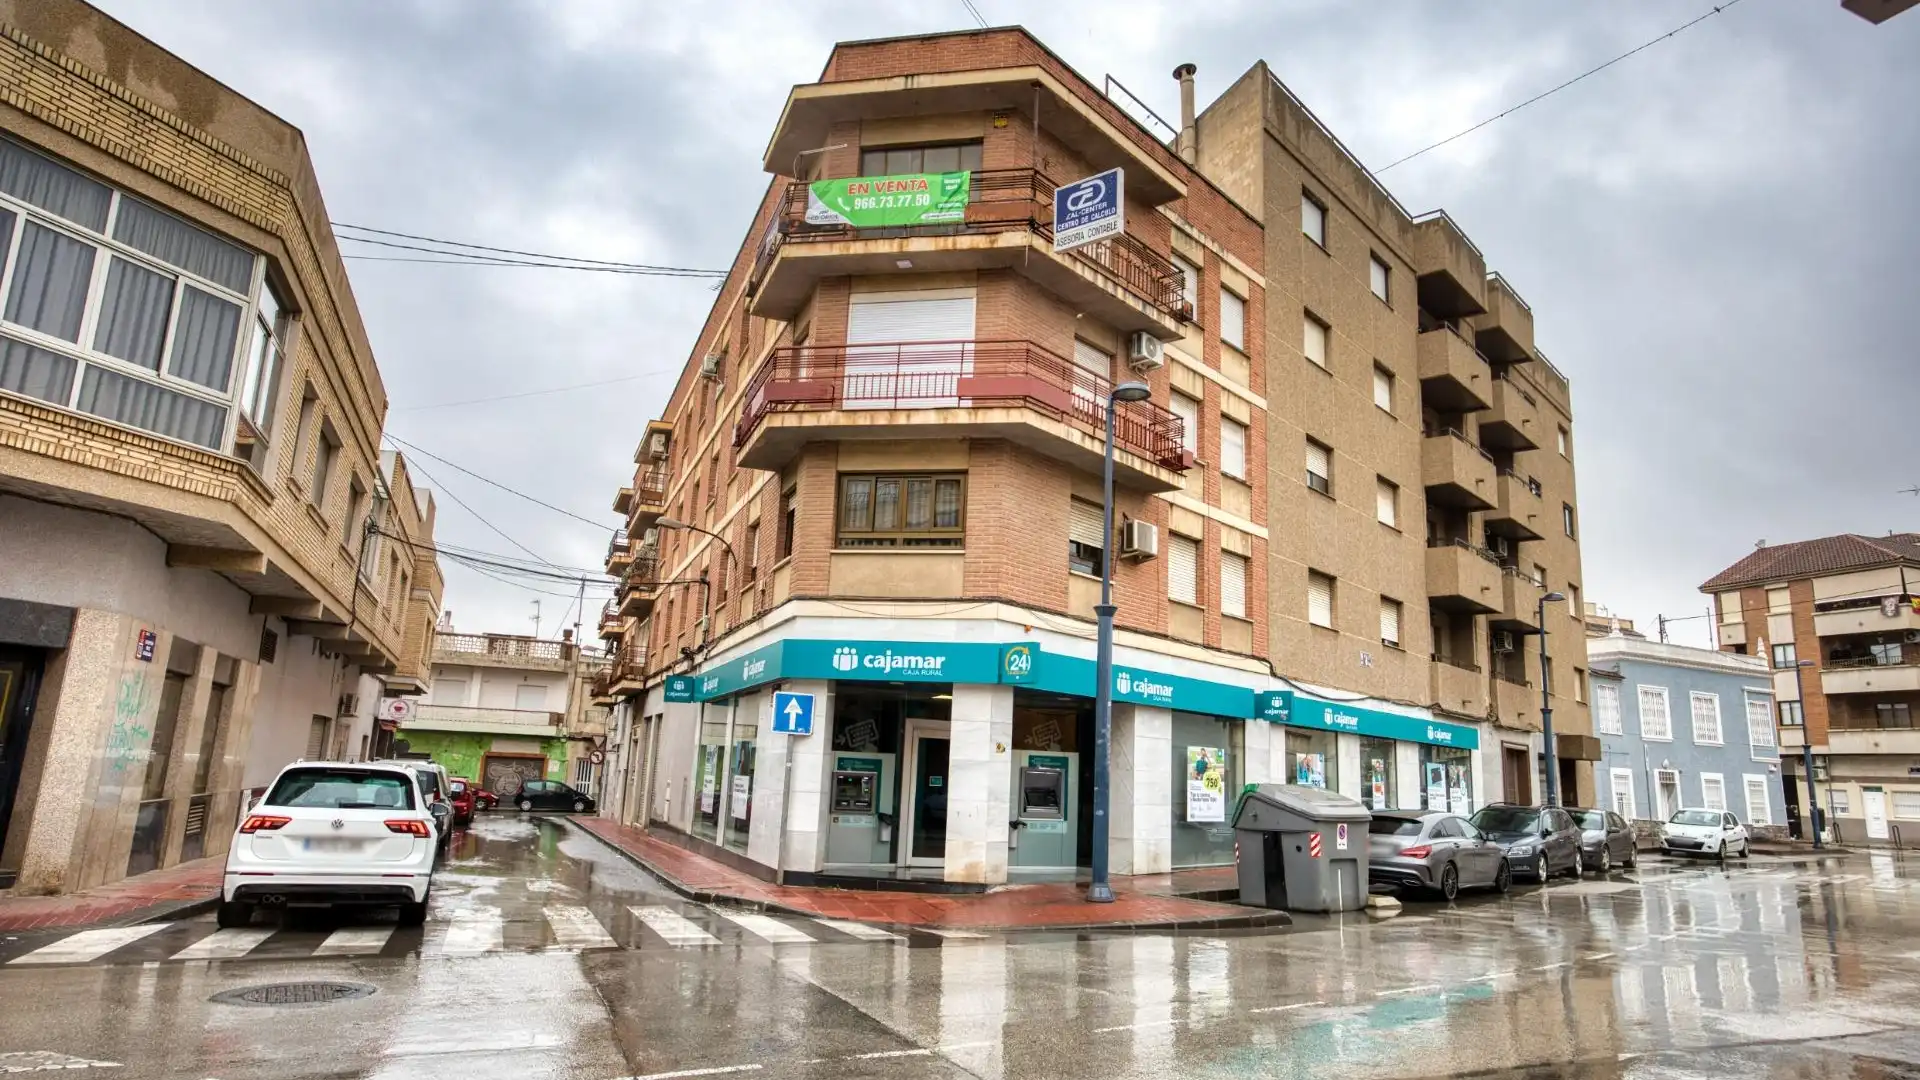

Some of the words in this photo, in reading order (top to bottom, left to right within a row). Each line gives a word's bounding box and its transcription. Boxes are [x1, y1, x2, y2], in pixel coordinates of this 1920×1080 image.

[848, 183, 869, 195] EN
[874, 178, 928, 194] VENTA
[854, 193, 930, 210] 966.73.77.50
[1057, 219, 1079, 231] CENTRO
[1081, 215, 1089, 224] DE
[1088, 220, 1118, 238] CONTABLE
[863, 650, 946, 673] cajamar
[921, 669, 943, 677] RURAL
[1133, 677, 1173, 698] cajamar
[1264, 708, 1289, 716] cajamar
[1334, 711, 1359, 729] cajamar
[1206, 777, 1218, 788] 750
